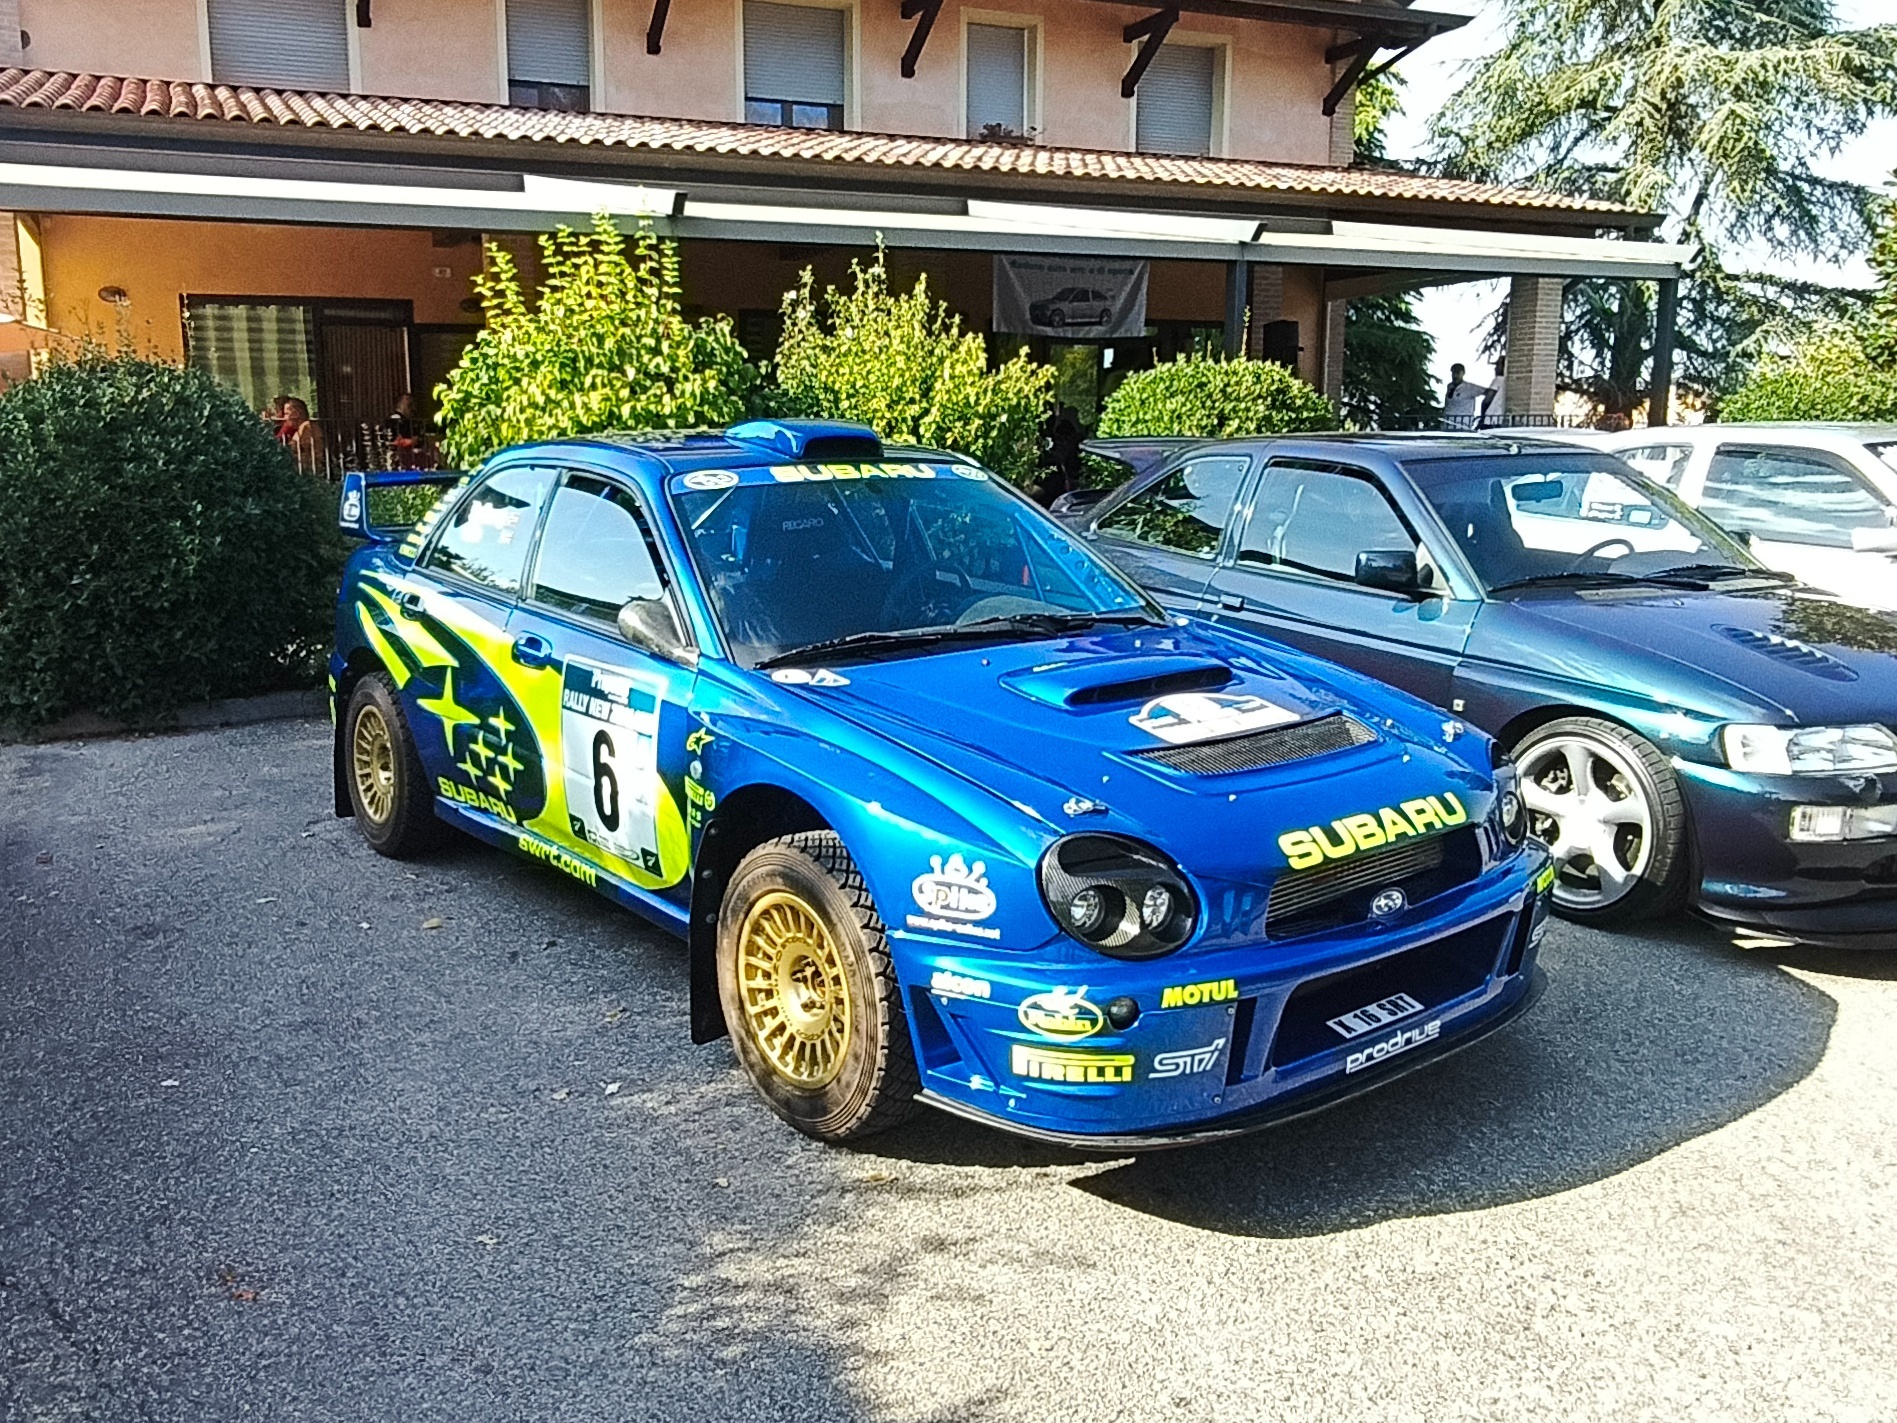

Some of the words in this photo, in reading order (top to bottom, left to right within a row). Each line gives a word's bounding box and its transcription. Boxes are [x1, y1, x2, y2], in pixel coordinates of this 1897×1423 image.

[770, 464, 936, 482] SUBARU
[563, 689, 589, 713] RALLY
[437, 776, 517, 824] SUBARU
[593, 729, 619, 832] 6
[1278, 792, 1467, 870] SUBARU
[518, 834, 597, 887] swrt.com
[1161, 979, 1238, 1008] MOTUL
[1353, 1009, 1382, 1026] 16
[1376, 995, 1416, 1017] SRT
[1012, 1044, 1135, 1082] PIRELLI
[1346, 1020, 1441, 1074] prodrive
